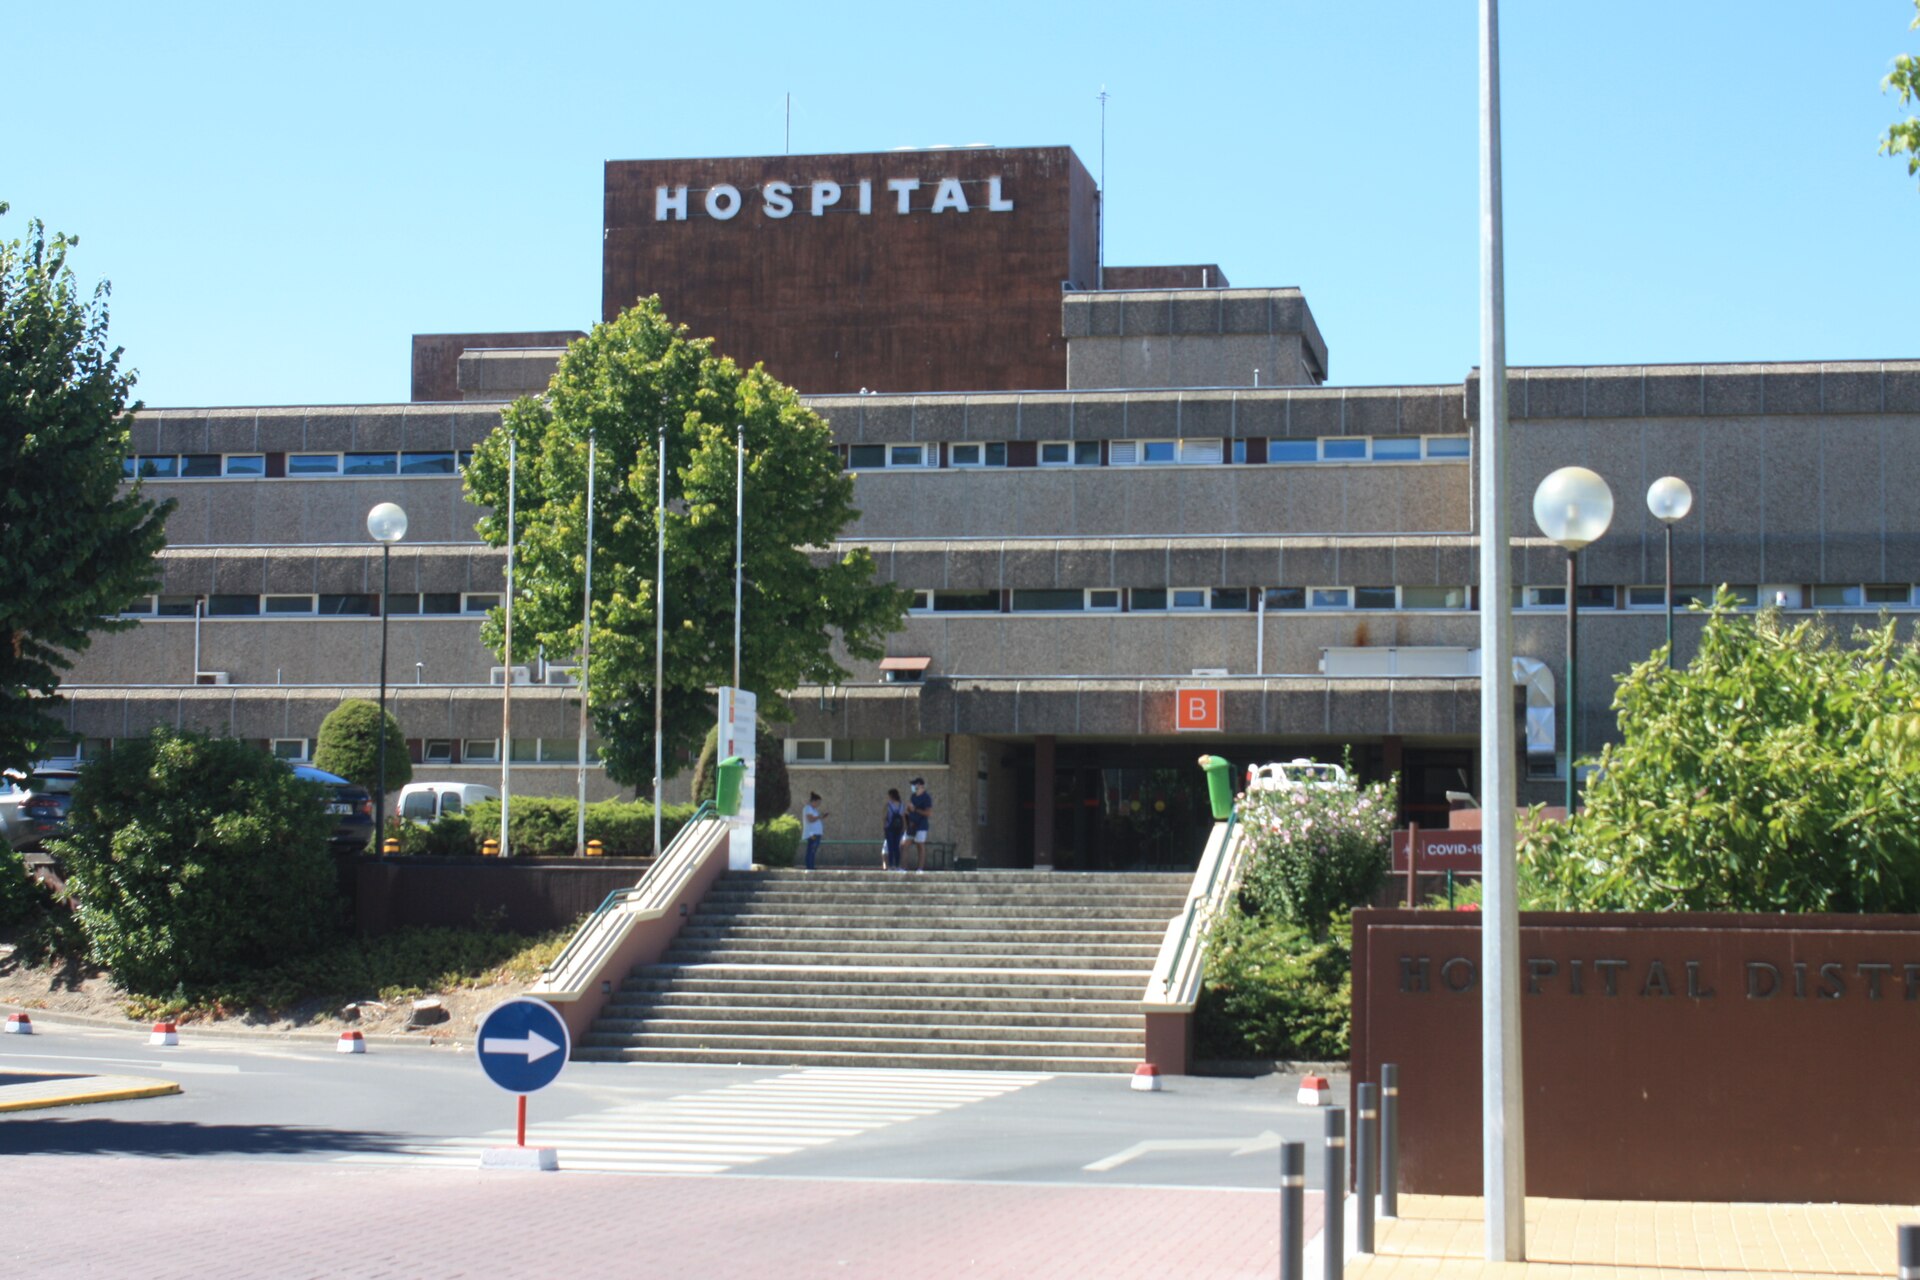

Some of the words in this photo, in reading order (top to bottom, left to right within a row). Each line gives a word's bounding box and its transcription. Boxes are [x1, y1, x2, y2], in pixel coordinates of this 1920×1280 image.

[655, 175, 1014, 221] HOSPITAL
[1189, 697, 1206, 720] B
[1399, 956, 1717, 999] HOPITAL
